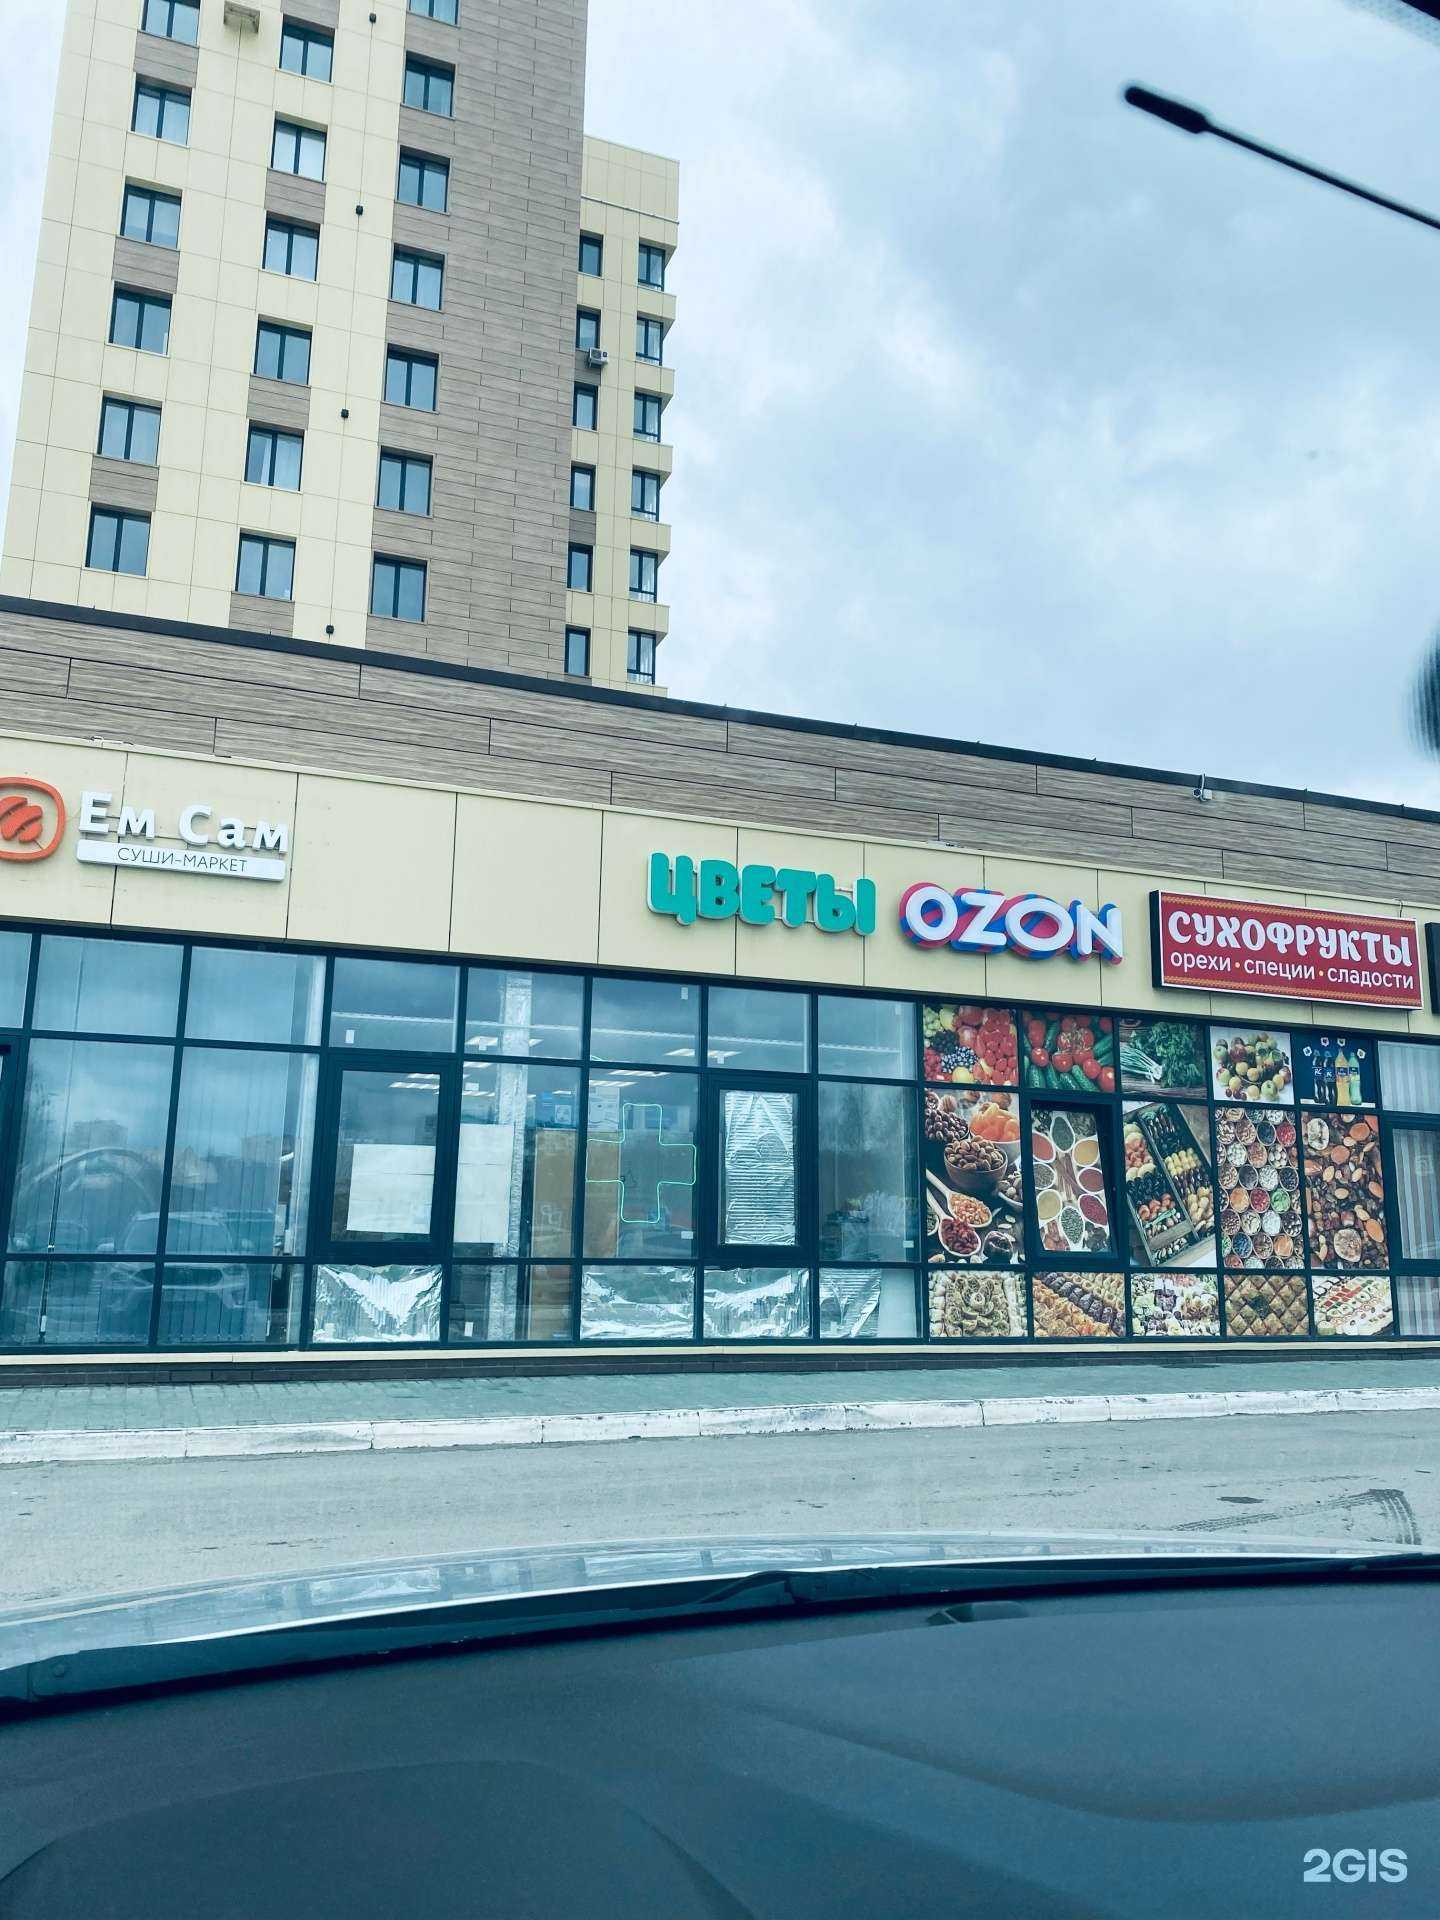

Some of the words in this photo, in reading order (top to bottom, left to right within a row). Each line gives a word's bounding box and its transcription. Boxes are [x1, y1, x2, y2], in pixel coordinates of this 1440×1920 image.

[79, 791, 156, 840] Ем
[178, 804, 289, 854] Сам
[117, 847, 248, 872] СУШИ-МАРКЕТ
[647, 852, 876, 936] ЦВЕТЫ
[901, 882, 1124, 965] OZON
[1168, 910, 1413, 967] СУХОФРУКТЫ
[1170, 951, 1231, 972] орехи
[1244, 958, 1315, 980] специи
[1327, 967, 1414, 989] сладости
